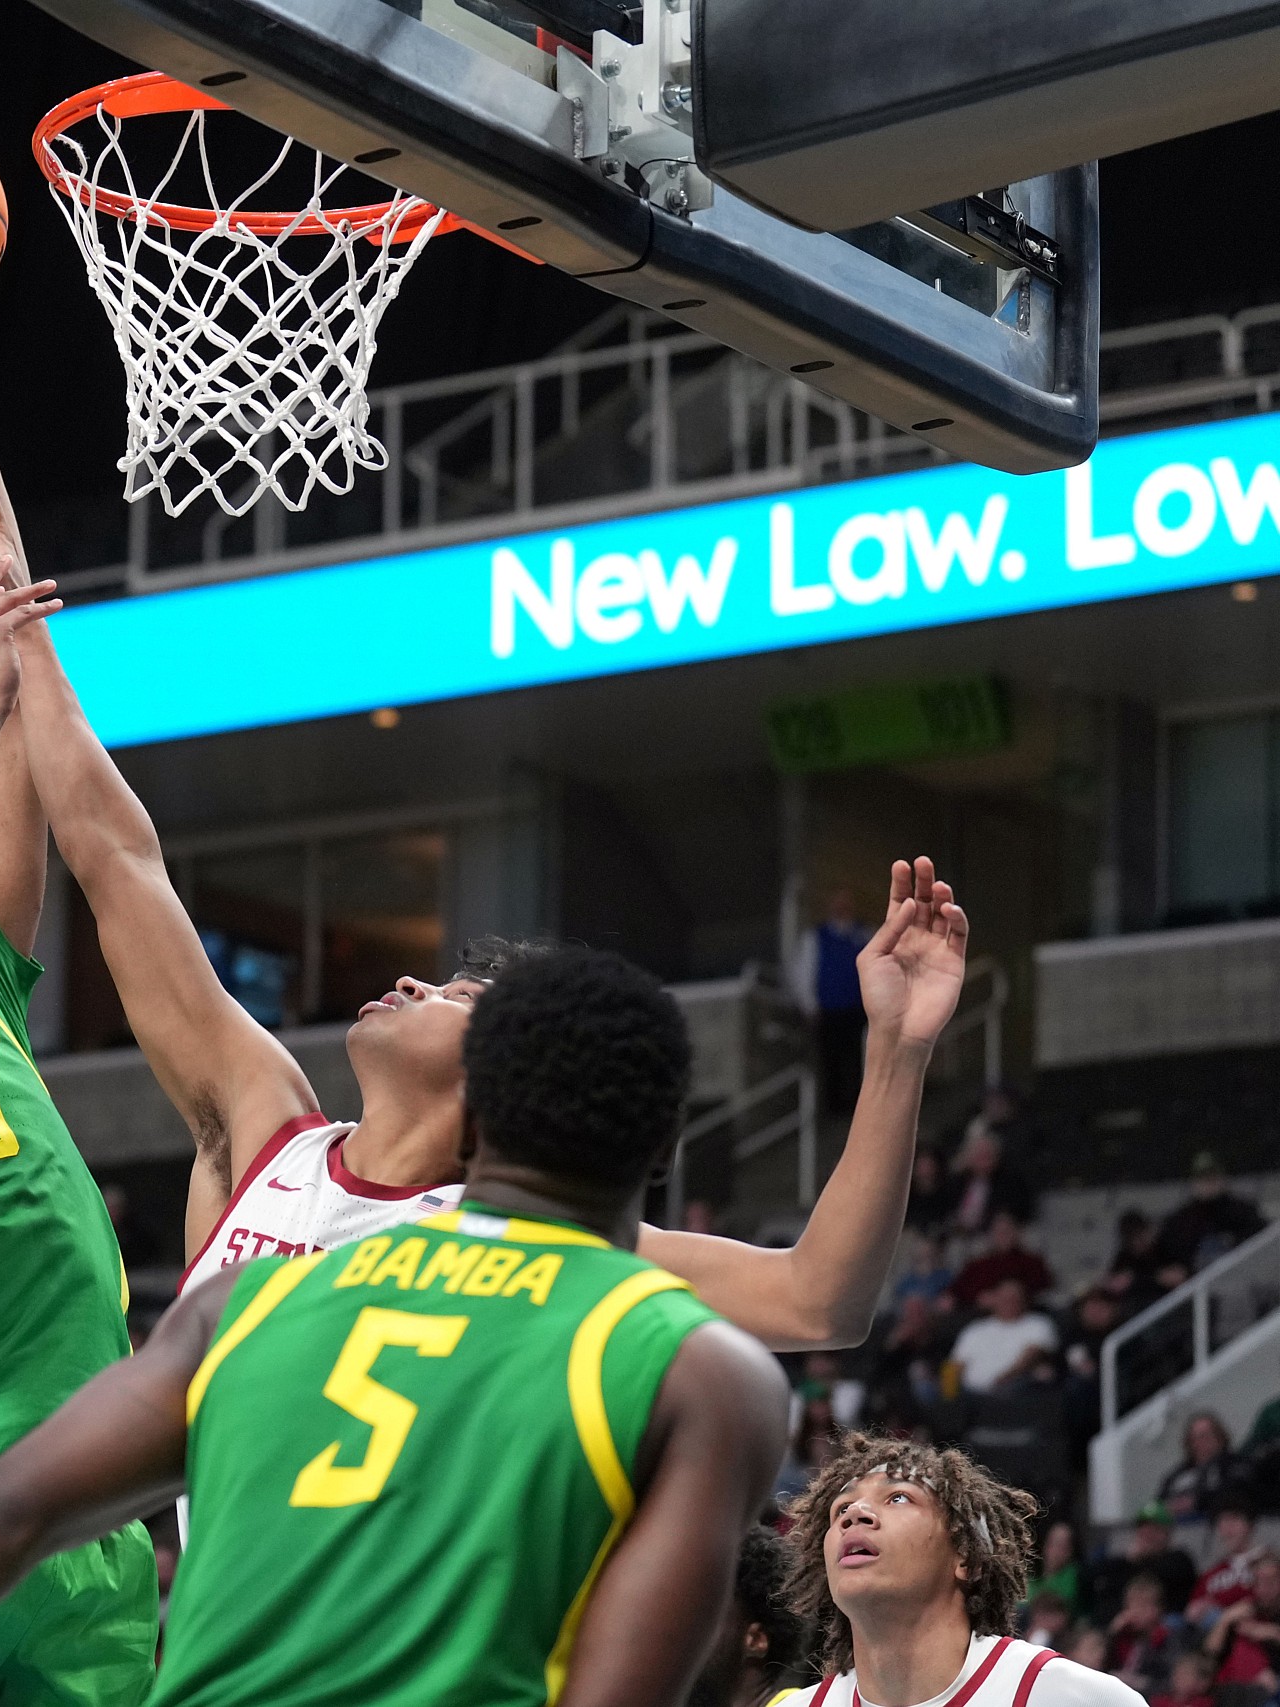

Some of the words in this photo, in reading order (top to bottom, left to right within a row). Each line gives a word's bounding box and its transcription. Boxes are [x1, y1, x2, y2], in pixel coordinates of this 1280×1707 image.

[490, 536, 739, 659] New
[769, 494, 1028, 616] Law.
[333, 1236, 565, 1307] BAMBA
[288, 1306, 470, 1509] 5
